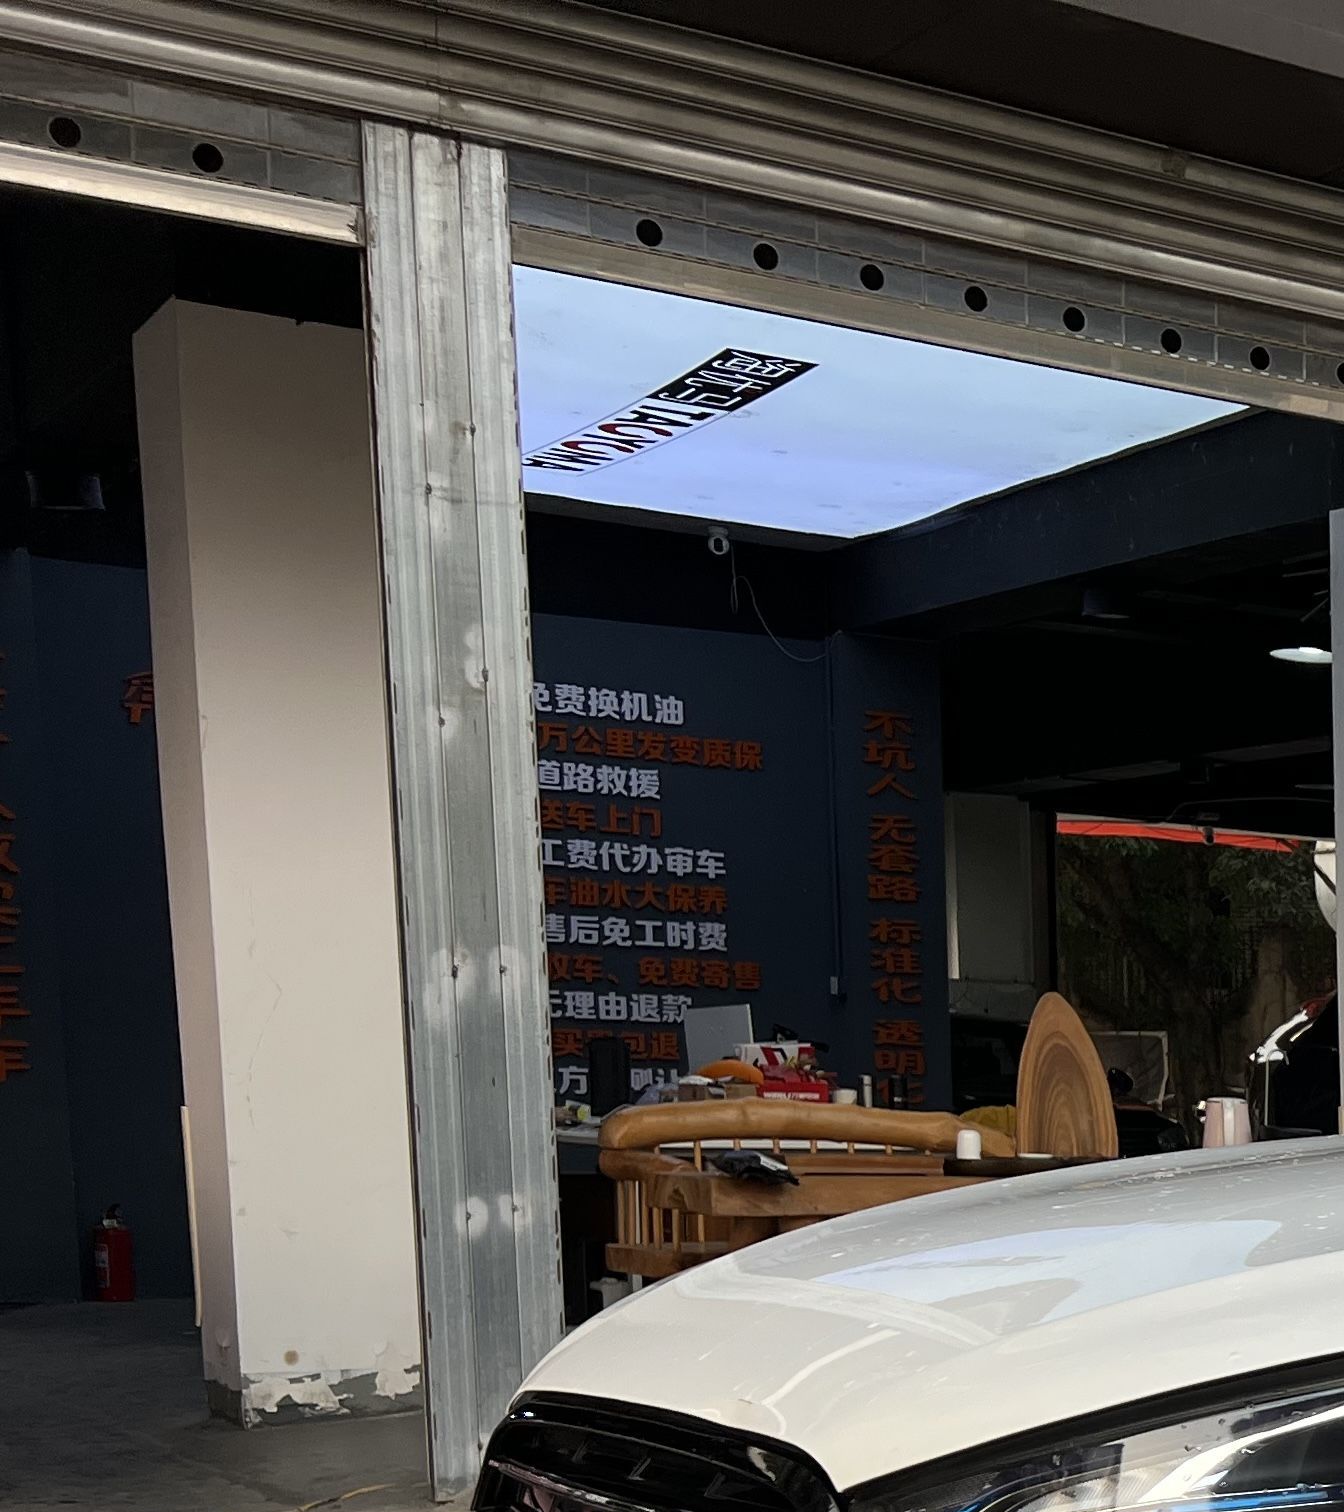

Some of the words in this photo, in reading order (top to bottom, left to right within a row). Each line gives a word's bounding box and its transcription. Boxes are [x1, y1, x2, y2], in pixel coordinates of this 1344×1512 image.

[538, 759, 662, 801] 道路救援
[864, 711, 916, 800] 不坑人
[868, 816, 921, 902] 无套路
[553, 1030, 681, 1061] 买包退
